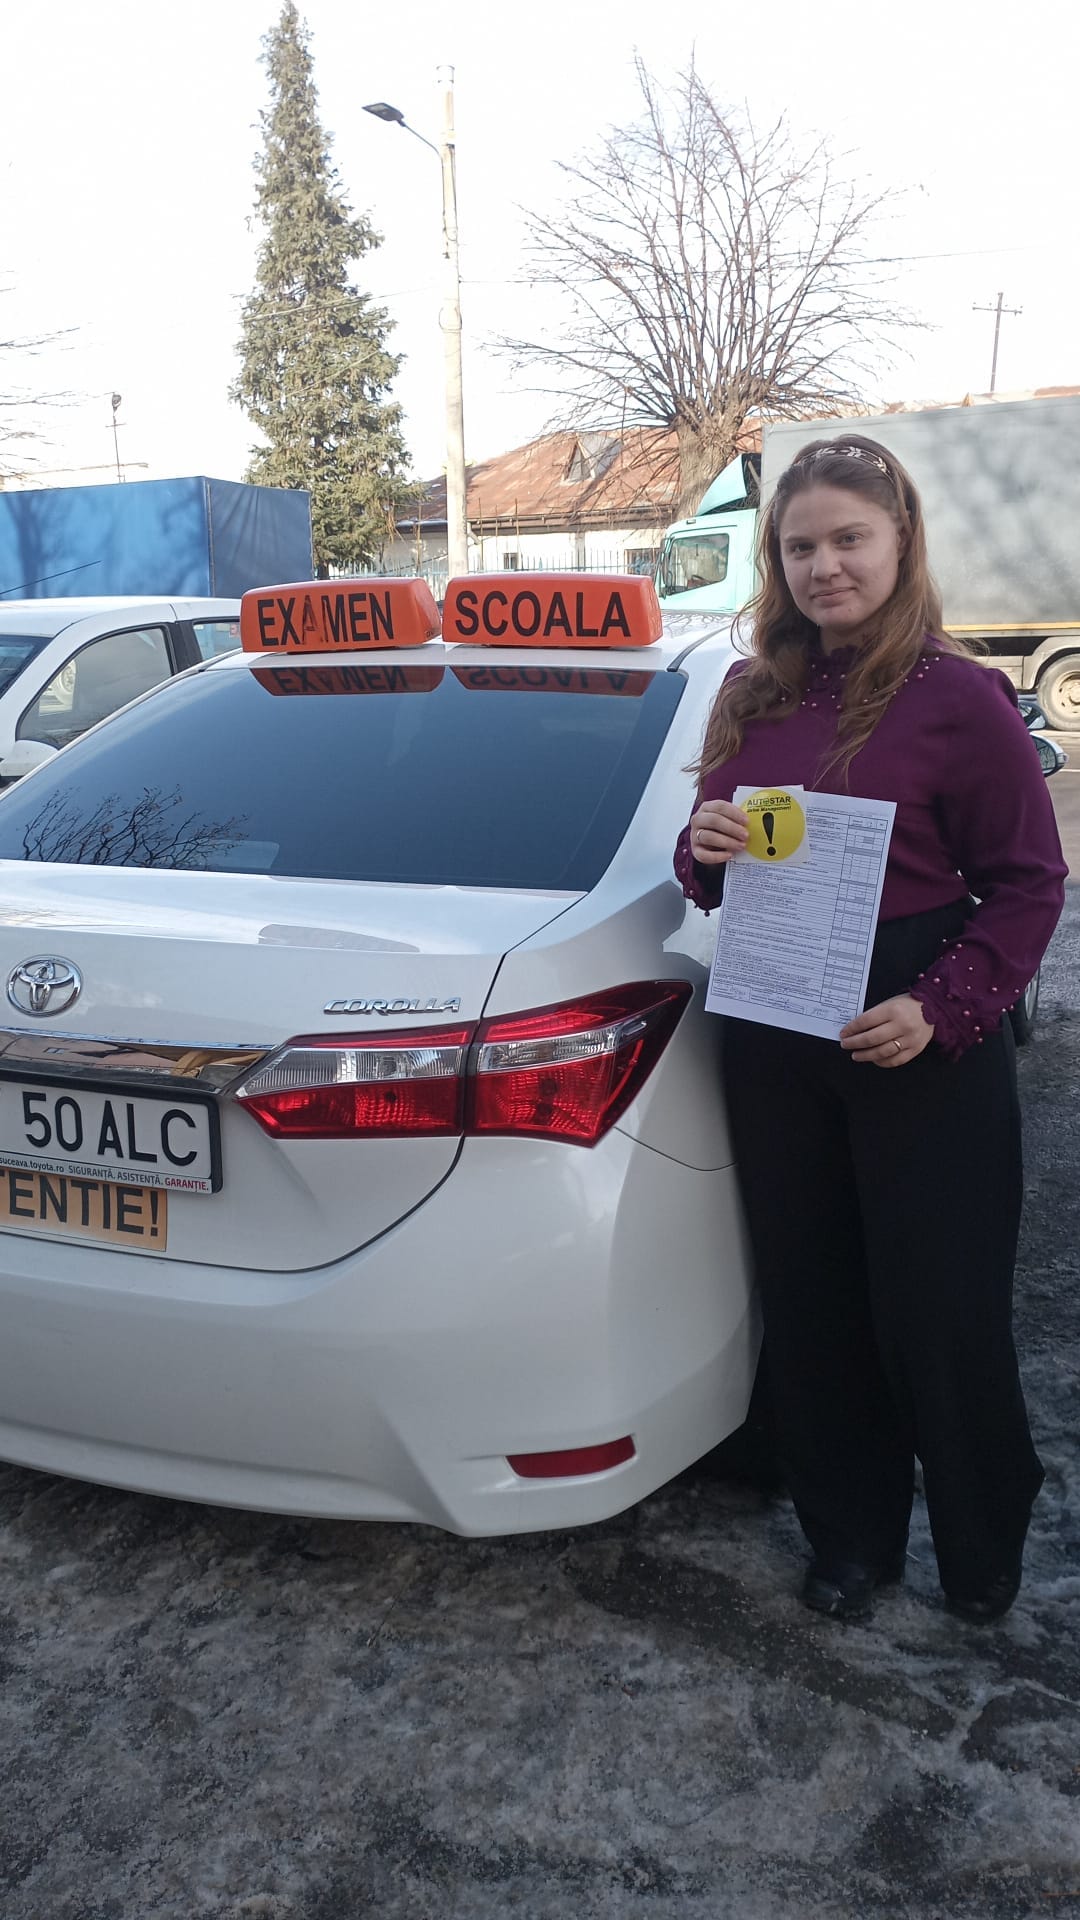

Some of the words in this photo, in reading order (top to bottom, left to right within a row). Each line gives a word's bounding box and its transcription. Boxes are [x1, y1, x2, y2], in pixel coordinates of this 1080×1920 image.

[257, 591, 394, 646] EXAMEN
[455, 590, 631, 637] SCOALA
[323, 997, 461, 1016] COROLLA
[22, 1091, 83, 1152] 50
[97, 1100, 197, 1166] ALC
[0, 1169, 159, 1237] ENTIE!
